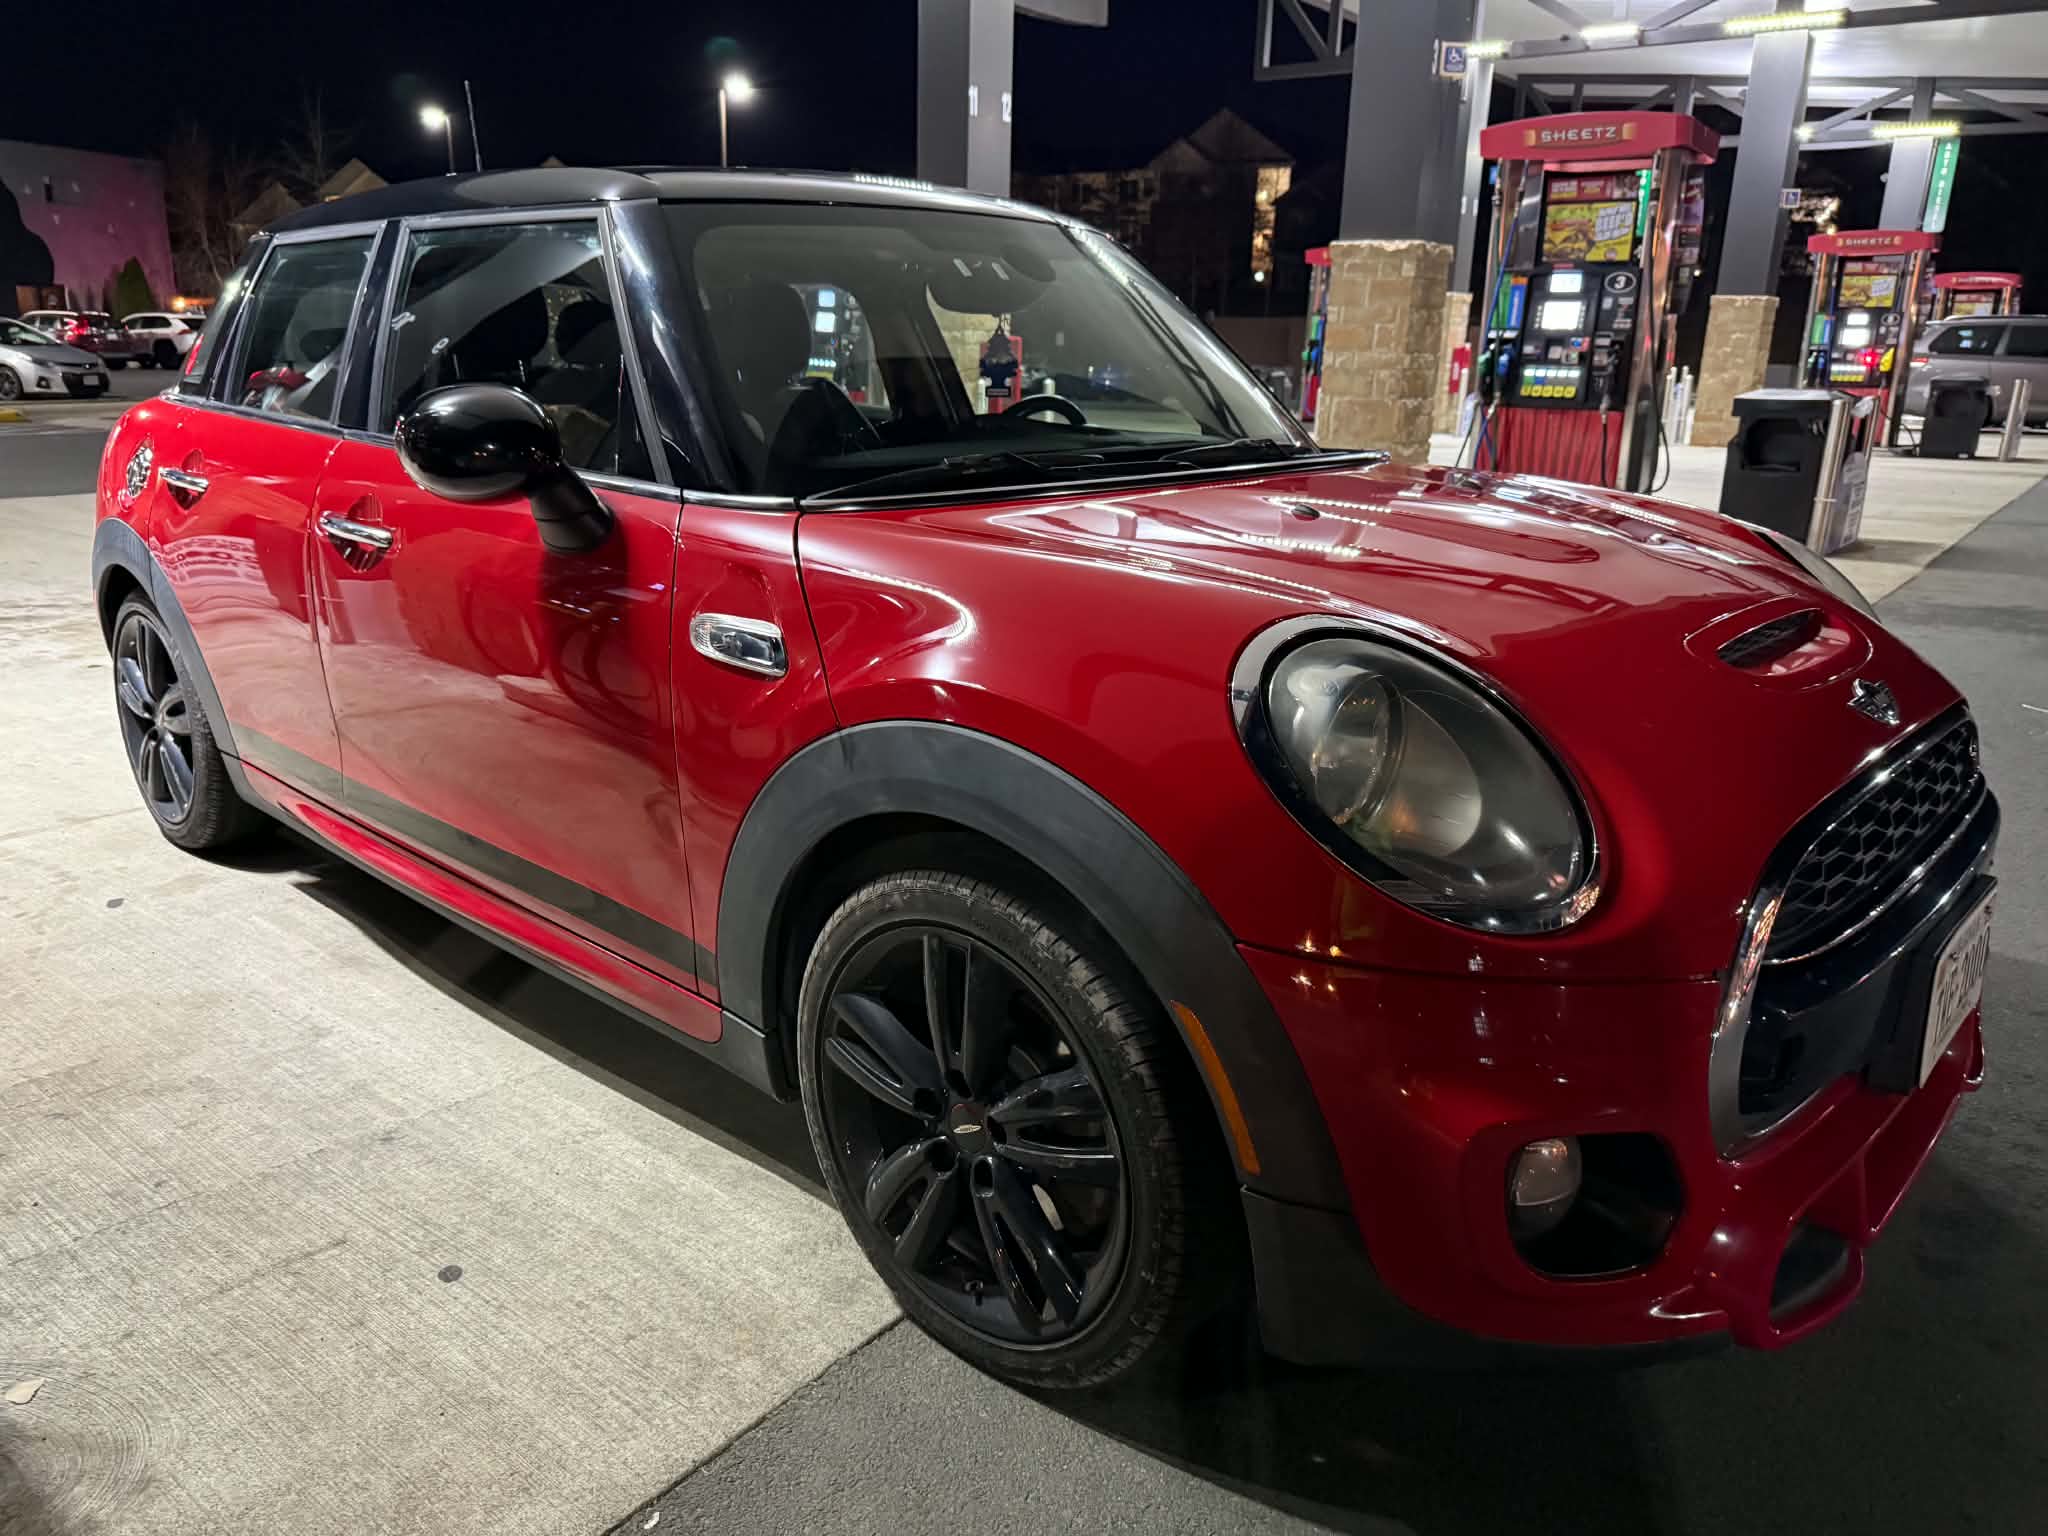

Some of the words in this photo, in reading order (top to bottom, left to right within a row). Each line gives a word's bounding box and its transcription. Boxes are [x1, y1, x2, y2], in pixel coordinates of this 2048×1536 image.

[968, 86, 978, 117] 11
[1002, 92, 1012, 122] 12
[1541, 126, 1617, 142] SHEETZ
[1614, 275, 1626, 289] 3
